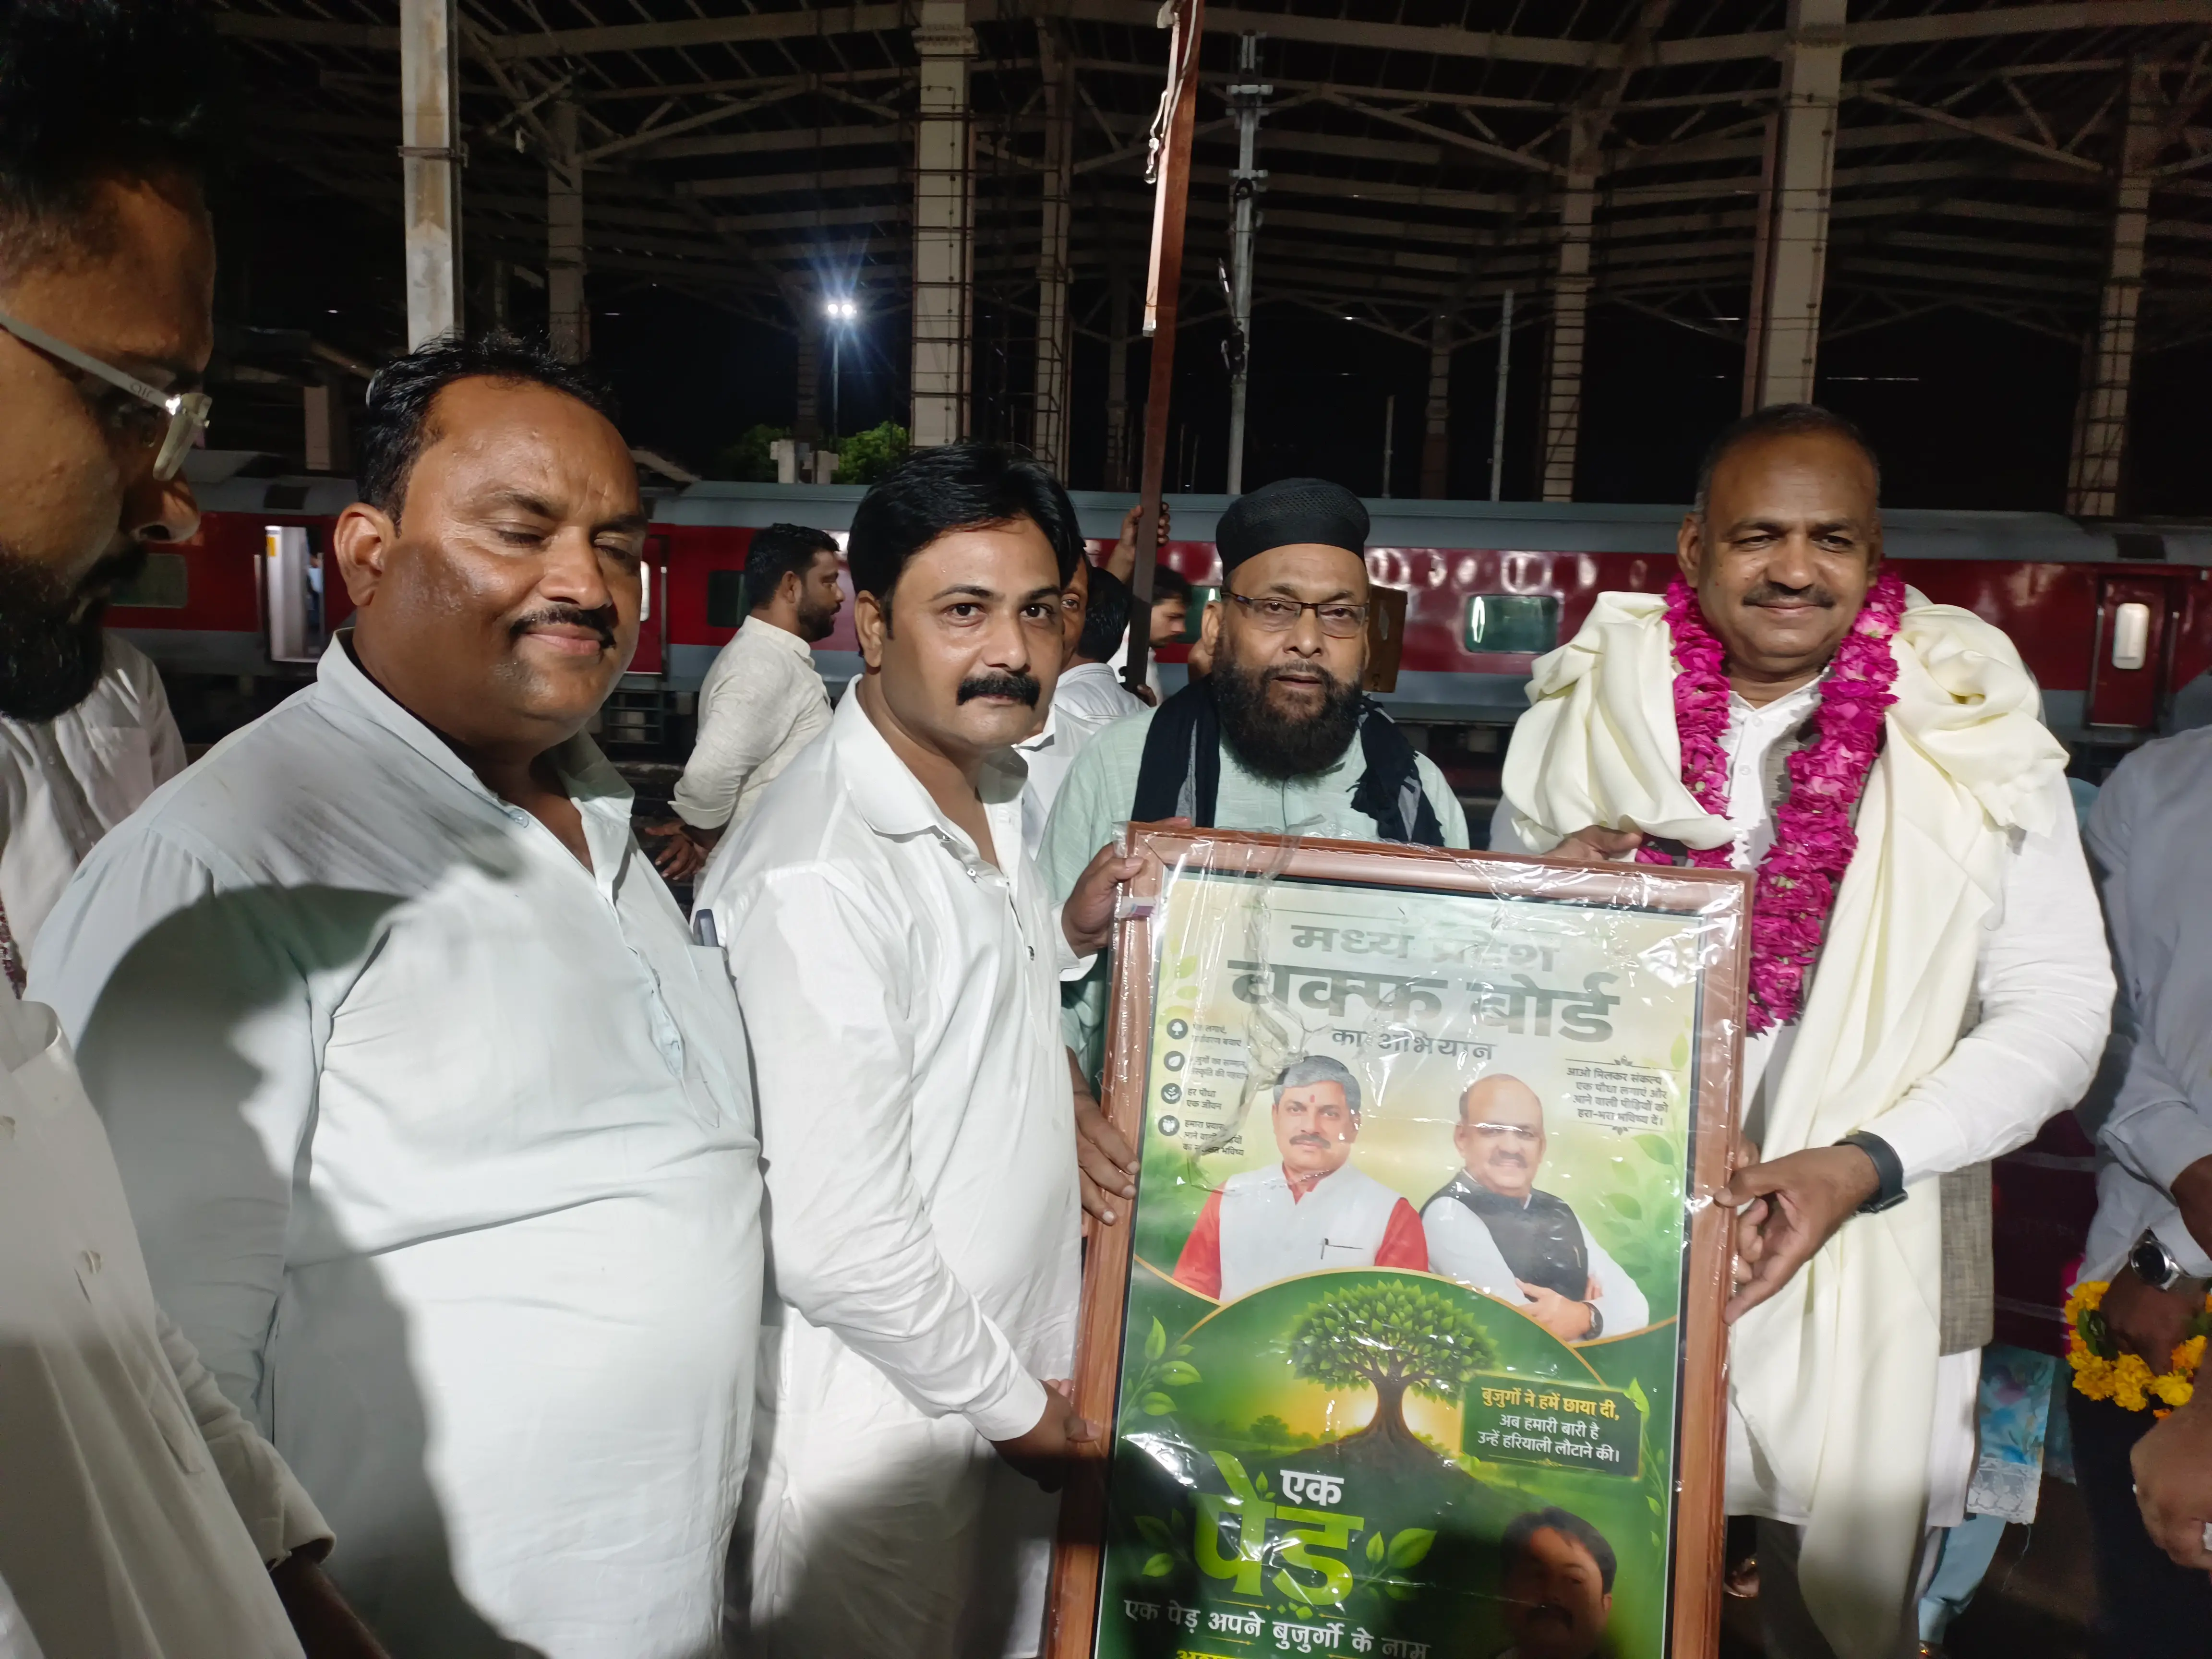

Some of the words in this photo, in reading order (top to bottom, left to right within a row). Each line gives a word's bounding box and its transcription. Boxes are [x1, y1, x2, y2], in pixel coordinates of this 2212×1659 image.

[1291, 925, 1415, 959] मध्य
[1466, 971, 1620, 1043] बोर्ड
[1332, 1029, 1368, 1047] का
[1566, 1067, 1591, 1078] आओ
[1187, 1088, 1197, 1096] हर
[1575, 1082, 1593, 1090] एक
[1649, 1088, 1668, 1099] और
[1186, 1099, 1200, 1107] एक
[1201, 1100, 1222, 1110] जीवन
[1654, 1102, 1669, 1112] को
[1524, 1388, 1537, 1407] ने
[1538, 1392, 1560, 1411] हमें
[1563, 1397, 1597, 1416] छाया
[1500, 1414, 1522, 1429] अब
[1524, 1416, 1558, 1434] हमारी
[1561, 1419, 1587, 1438] बारी
[1589, 1421, 1600, 1441] है
[1477, 1429, 1501, 1447] उन्हें
[1503, 1431, 1552, 1454] हरियाली
[1554, 1438, 1593, 1459] लौटाने
[1280, 1469, 1345, 1506] एक
[1124, 1599, 1161, 1622] एक
[1167, 1599, 1201, 1634] पेड़
[1208, 1611, 1265, 1638] अपने
[1351, 1628, 1374, 1653] के
[1381, 1636, 1431, 1659] नाम
